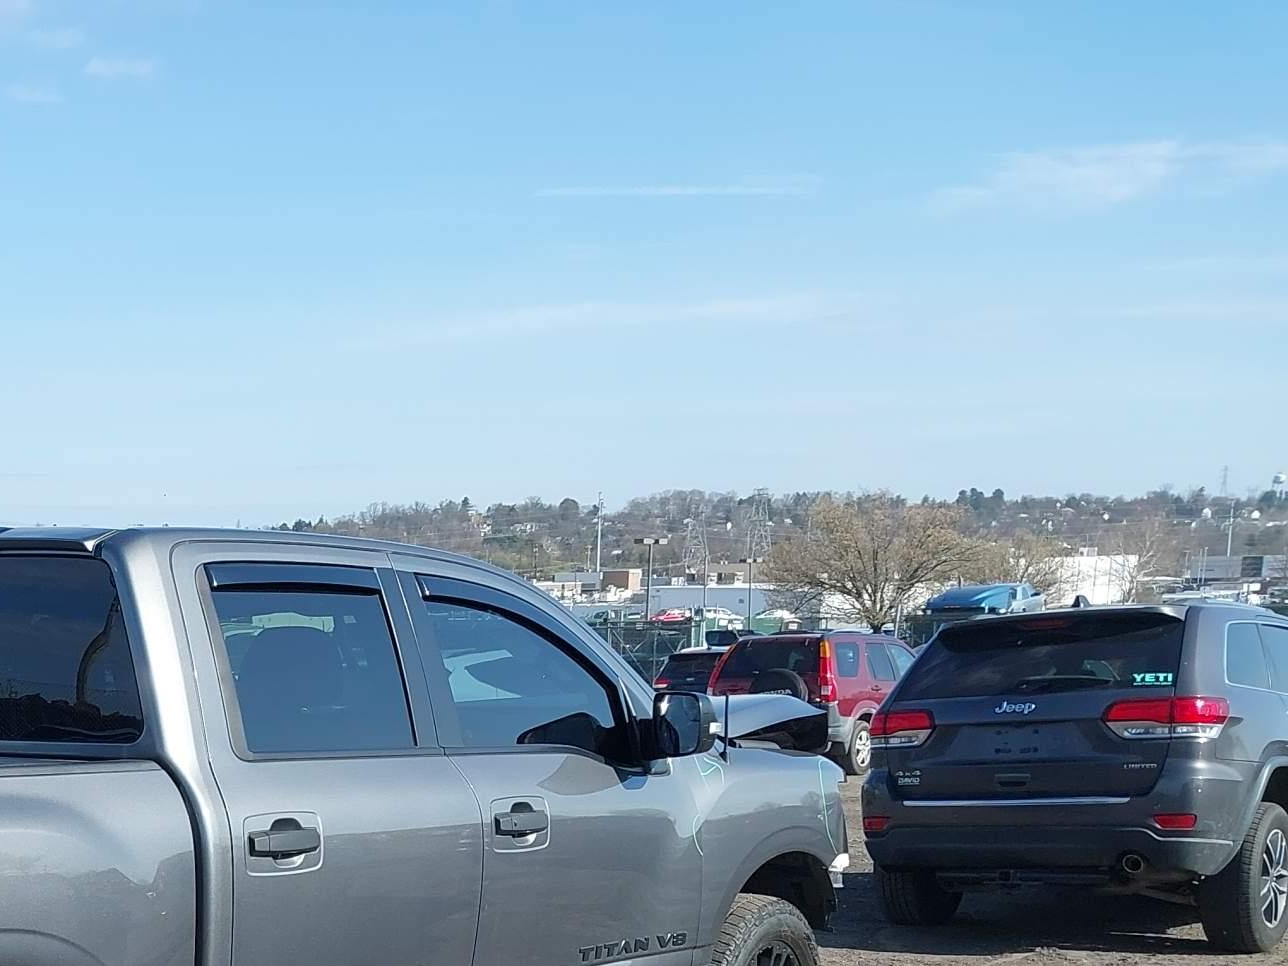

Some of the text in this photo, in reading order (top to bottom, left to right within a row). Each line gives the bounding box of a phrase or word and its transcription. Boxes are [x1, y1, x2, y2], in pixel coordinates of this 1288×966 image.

[1132, 673, 1173, 682] YETI
[995, 701, 1036, 715] Jeep
[579, 932, 688, 962] TITAN V8
